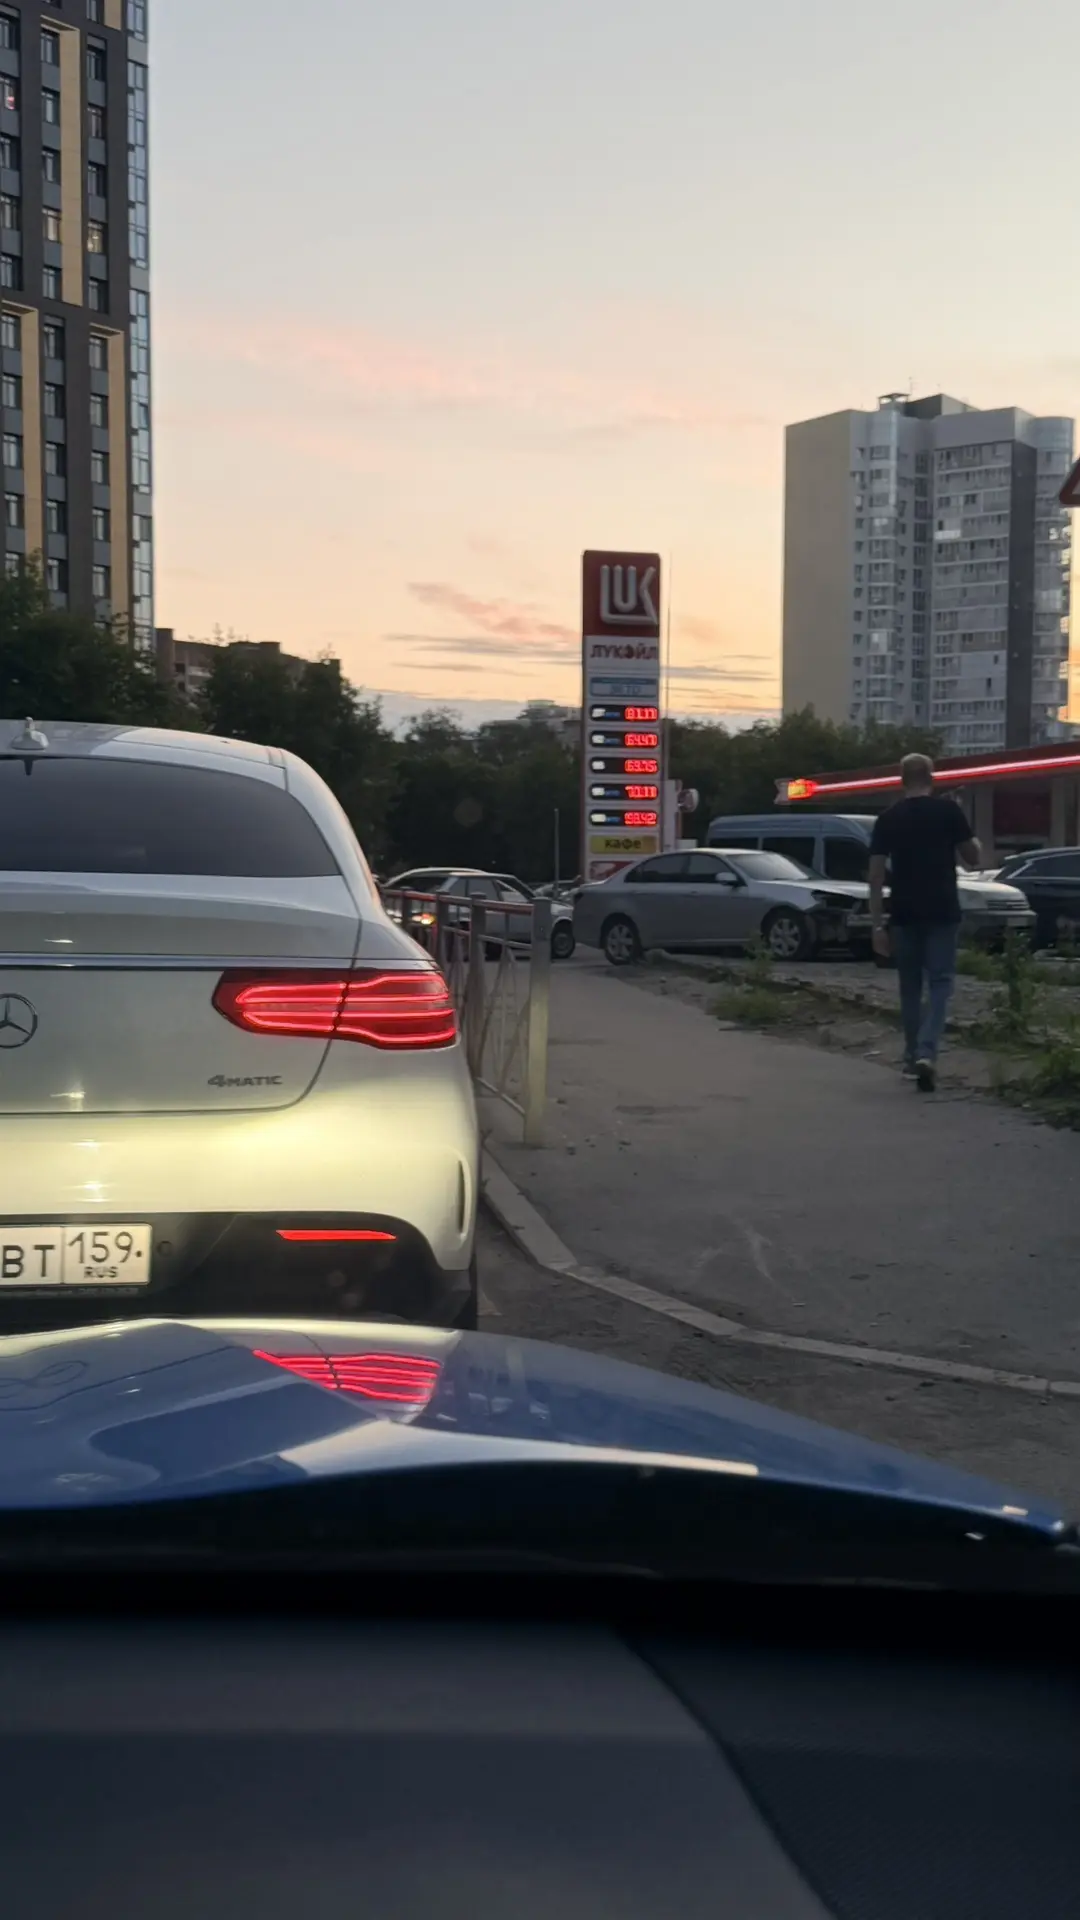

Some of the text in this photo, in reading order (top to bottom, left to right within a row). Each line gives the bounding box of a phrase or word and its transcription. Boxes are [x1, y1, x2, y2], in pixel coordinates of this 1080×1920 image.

[590, 642, 658, 660] ЛУКОЙЛ
[207, 1074, 283, 1088] 4MATIC
[68, 1231, 134, 1264] 159
[83, 1266, 118, 1278] RUS
